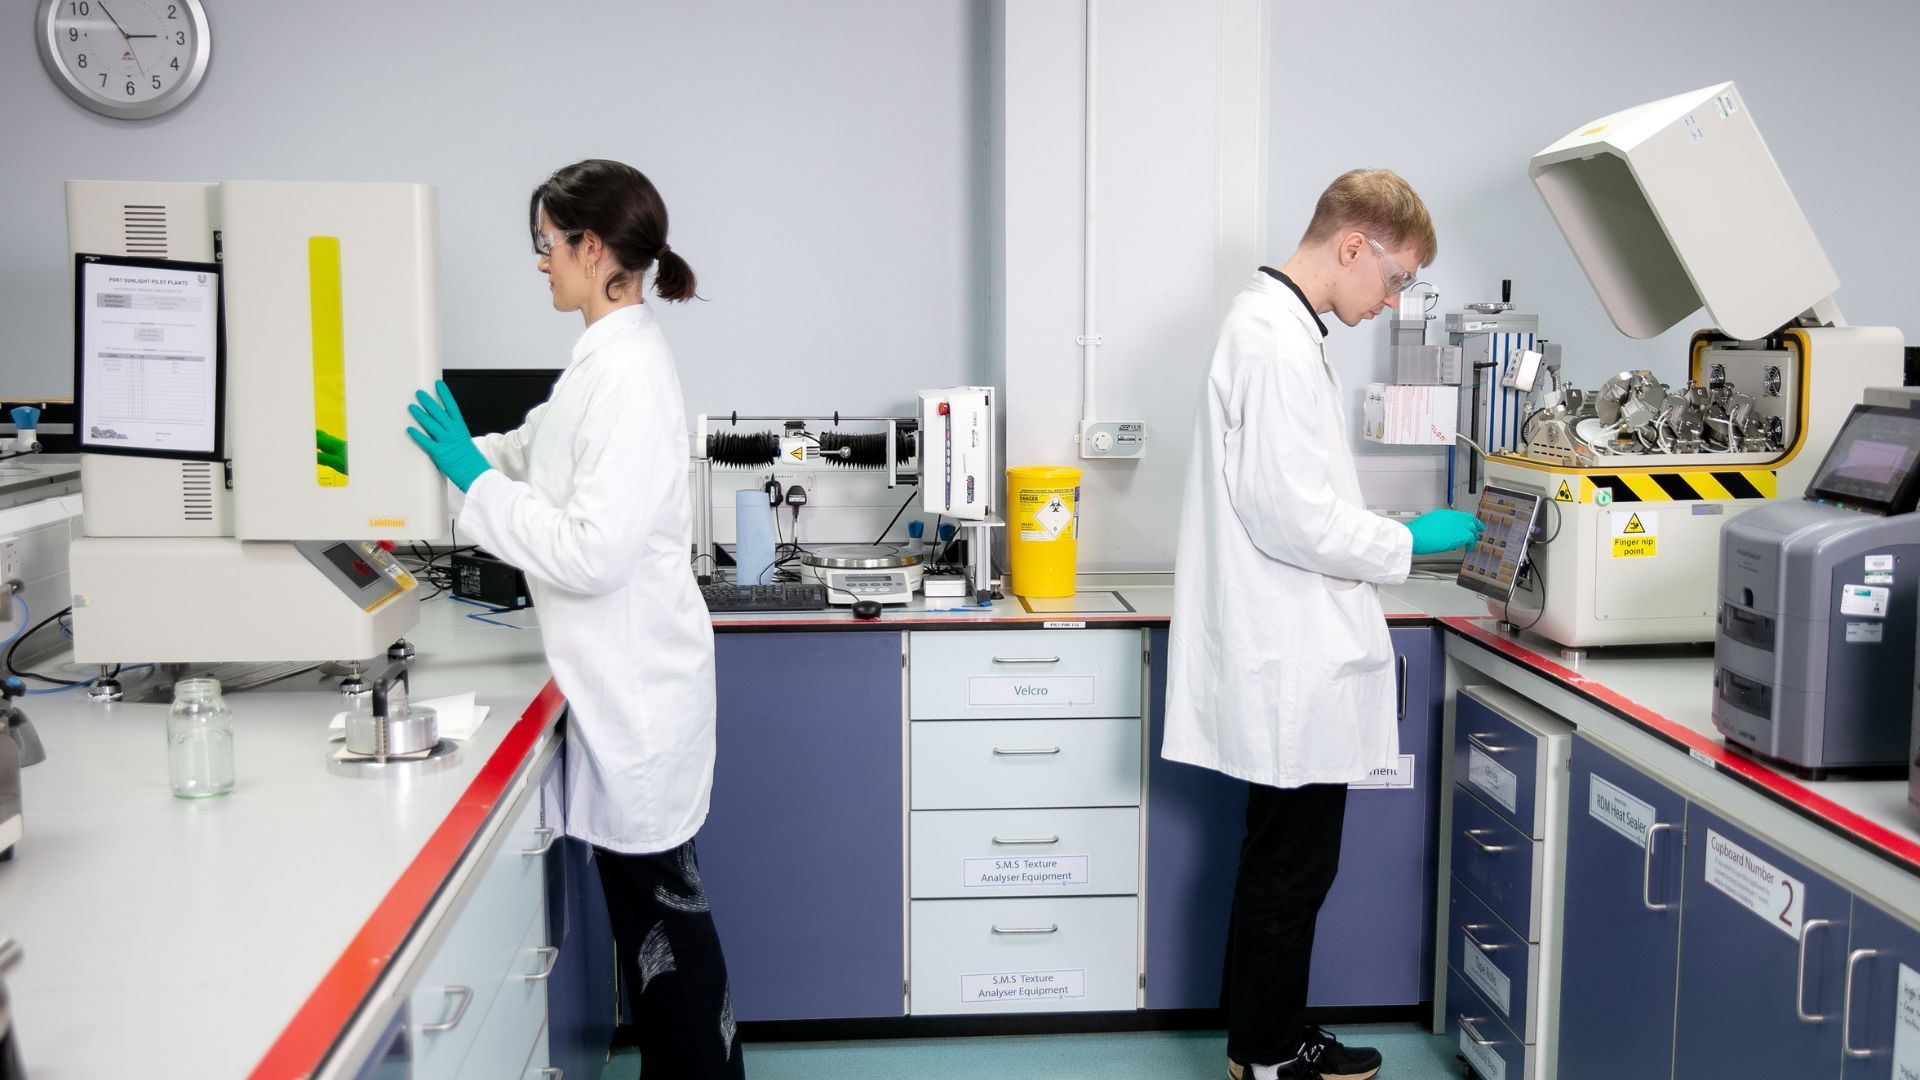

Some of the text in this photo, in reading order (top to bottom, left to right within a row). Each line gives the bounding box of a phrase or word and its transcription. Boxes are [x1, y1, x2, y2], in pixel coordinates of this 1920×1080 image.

[70, 2, 88, 16] 10
[168, 5, 177, 20] 2
[69, 28, 78, 42] 9
[176, 31, 185, 45] 3
[78, 54, 88, 68] 8
[170, 57, 180, 71] 4
[99, 74, 108, 87] 7
[152, 75, 161, 89] 5
[126, 82, 135, 96] 6
[1615, 538, 1653, 547] Finger nip
[1014, 685, 1048, 695] Velcro
[1597, 794, 1610, 813] RDM
[1612, 802, 1625, 823] Heat
[1626, 812, 1646, 834] Sealer
[996, 860, 1057, 869] S.M.S Texture
[1711, 836, 1774, 884] Cupboard Number
[981, 872, 1072, 883] Analyser Equipment
[1779, 880, 1794, 926] 2
[993, 974, 1054, 984] S.M.S Texture
[978, 986, 1068, 998] Analyser Equipment
